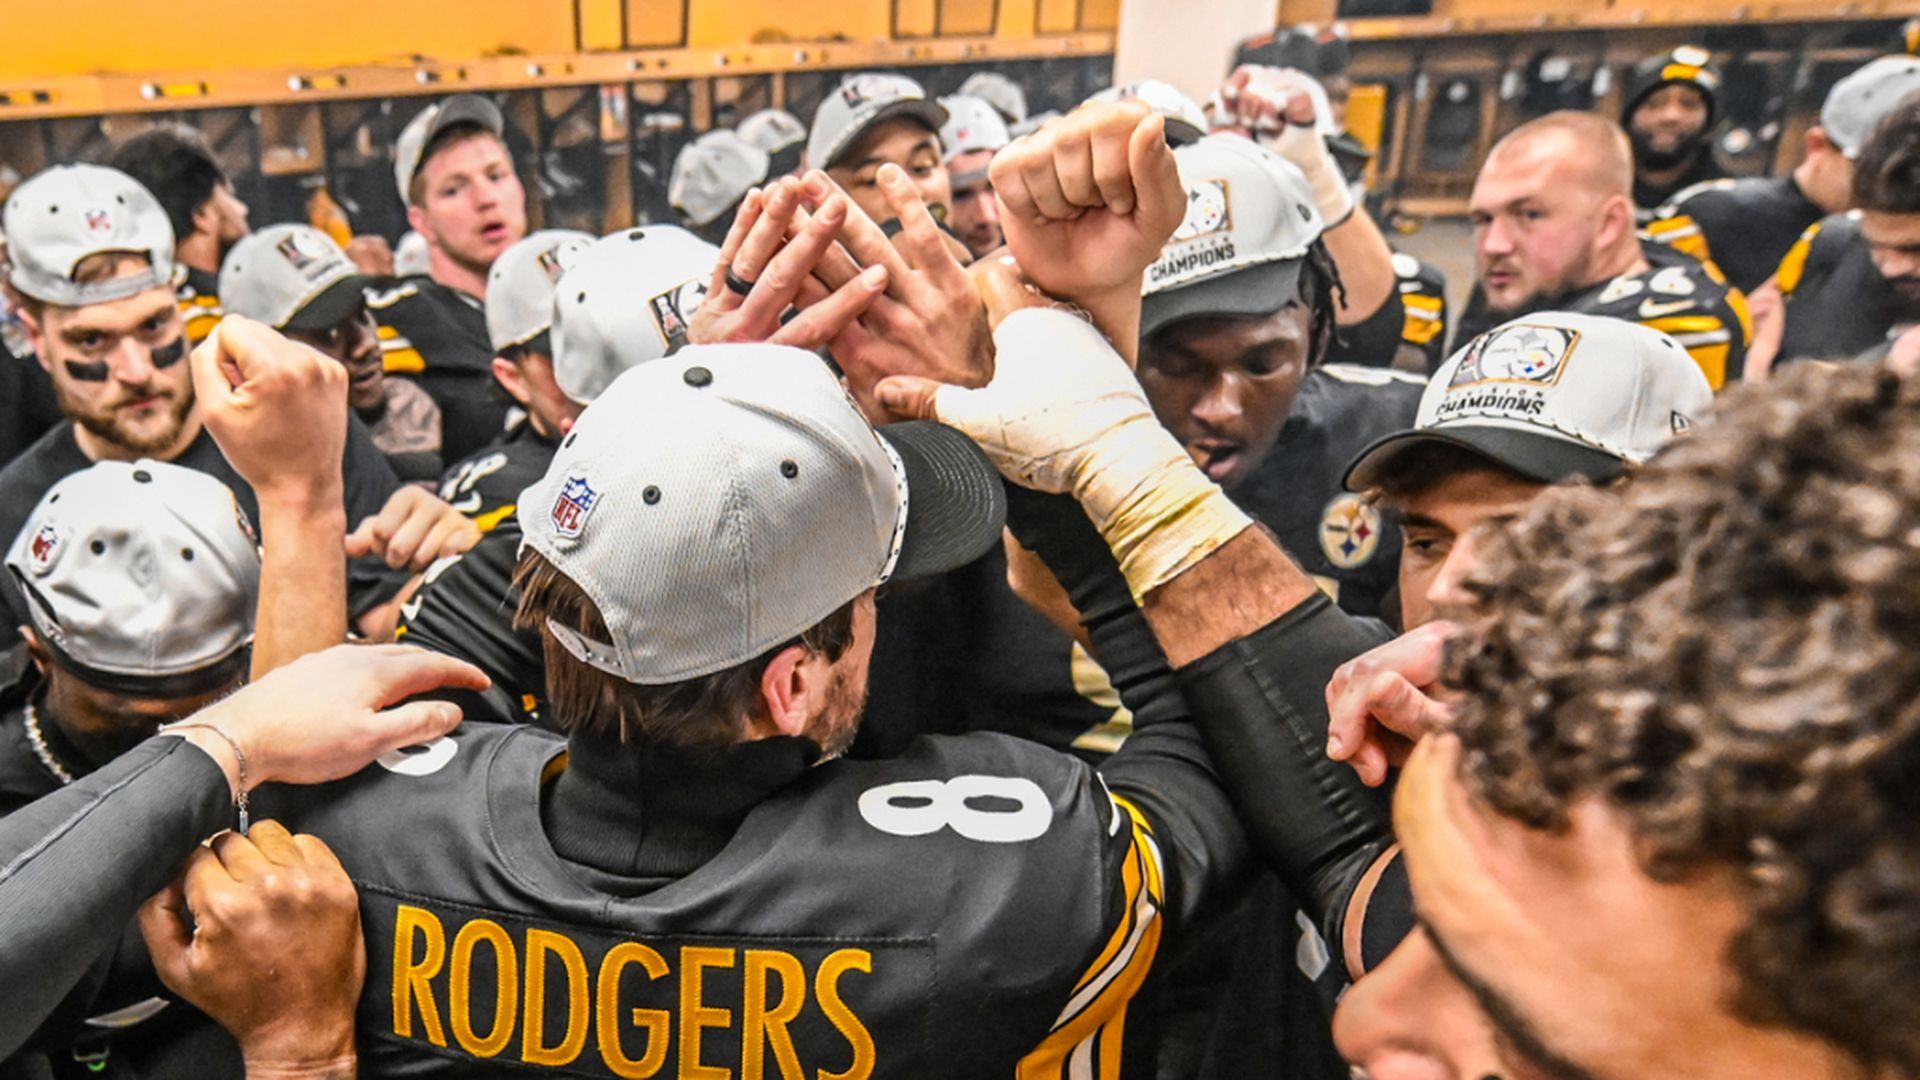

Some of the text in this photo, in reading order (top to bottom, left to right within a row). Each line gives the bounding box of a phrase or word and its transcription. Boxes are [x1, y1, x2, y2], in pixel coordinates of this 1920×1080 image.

[1150, 243, 1236, 283] CHAMPIONS
[1435, 394, 1546, 416] CHAMPIONS
[553, 496, 583, 531] NFL
[857, 773, 1054, 843] 8
[393, 904, 876, 1080] RODGERS
